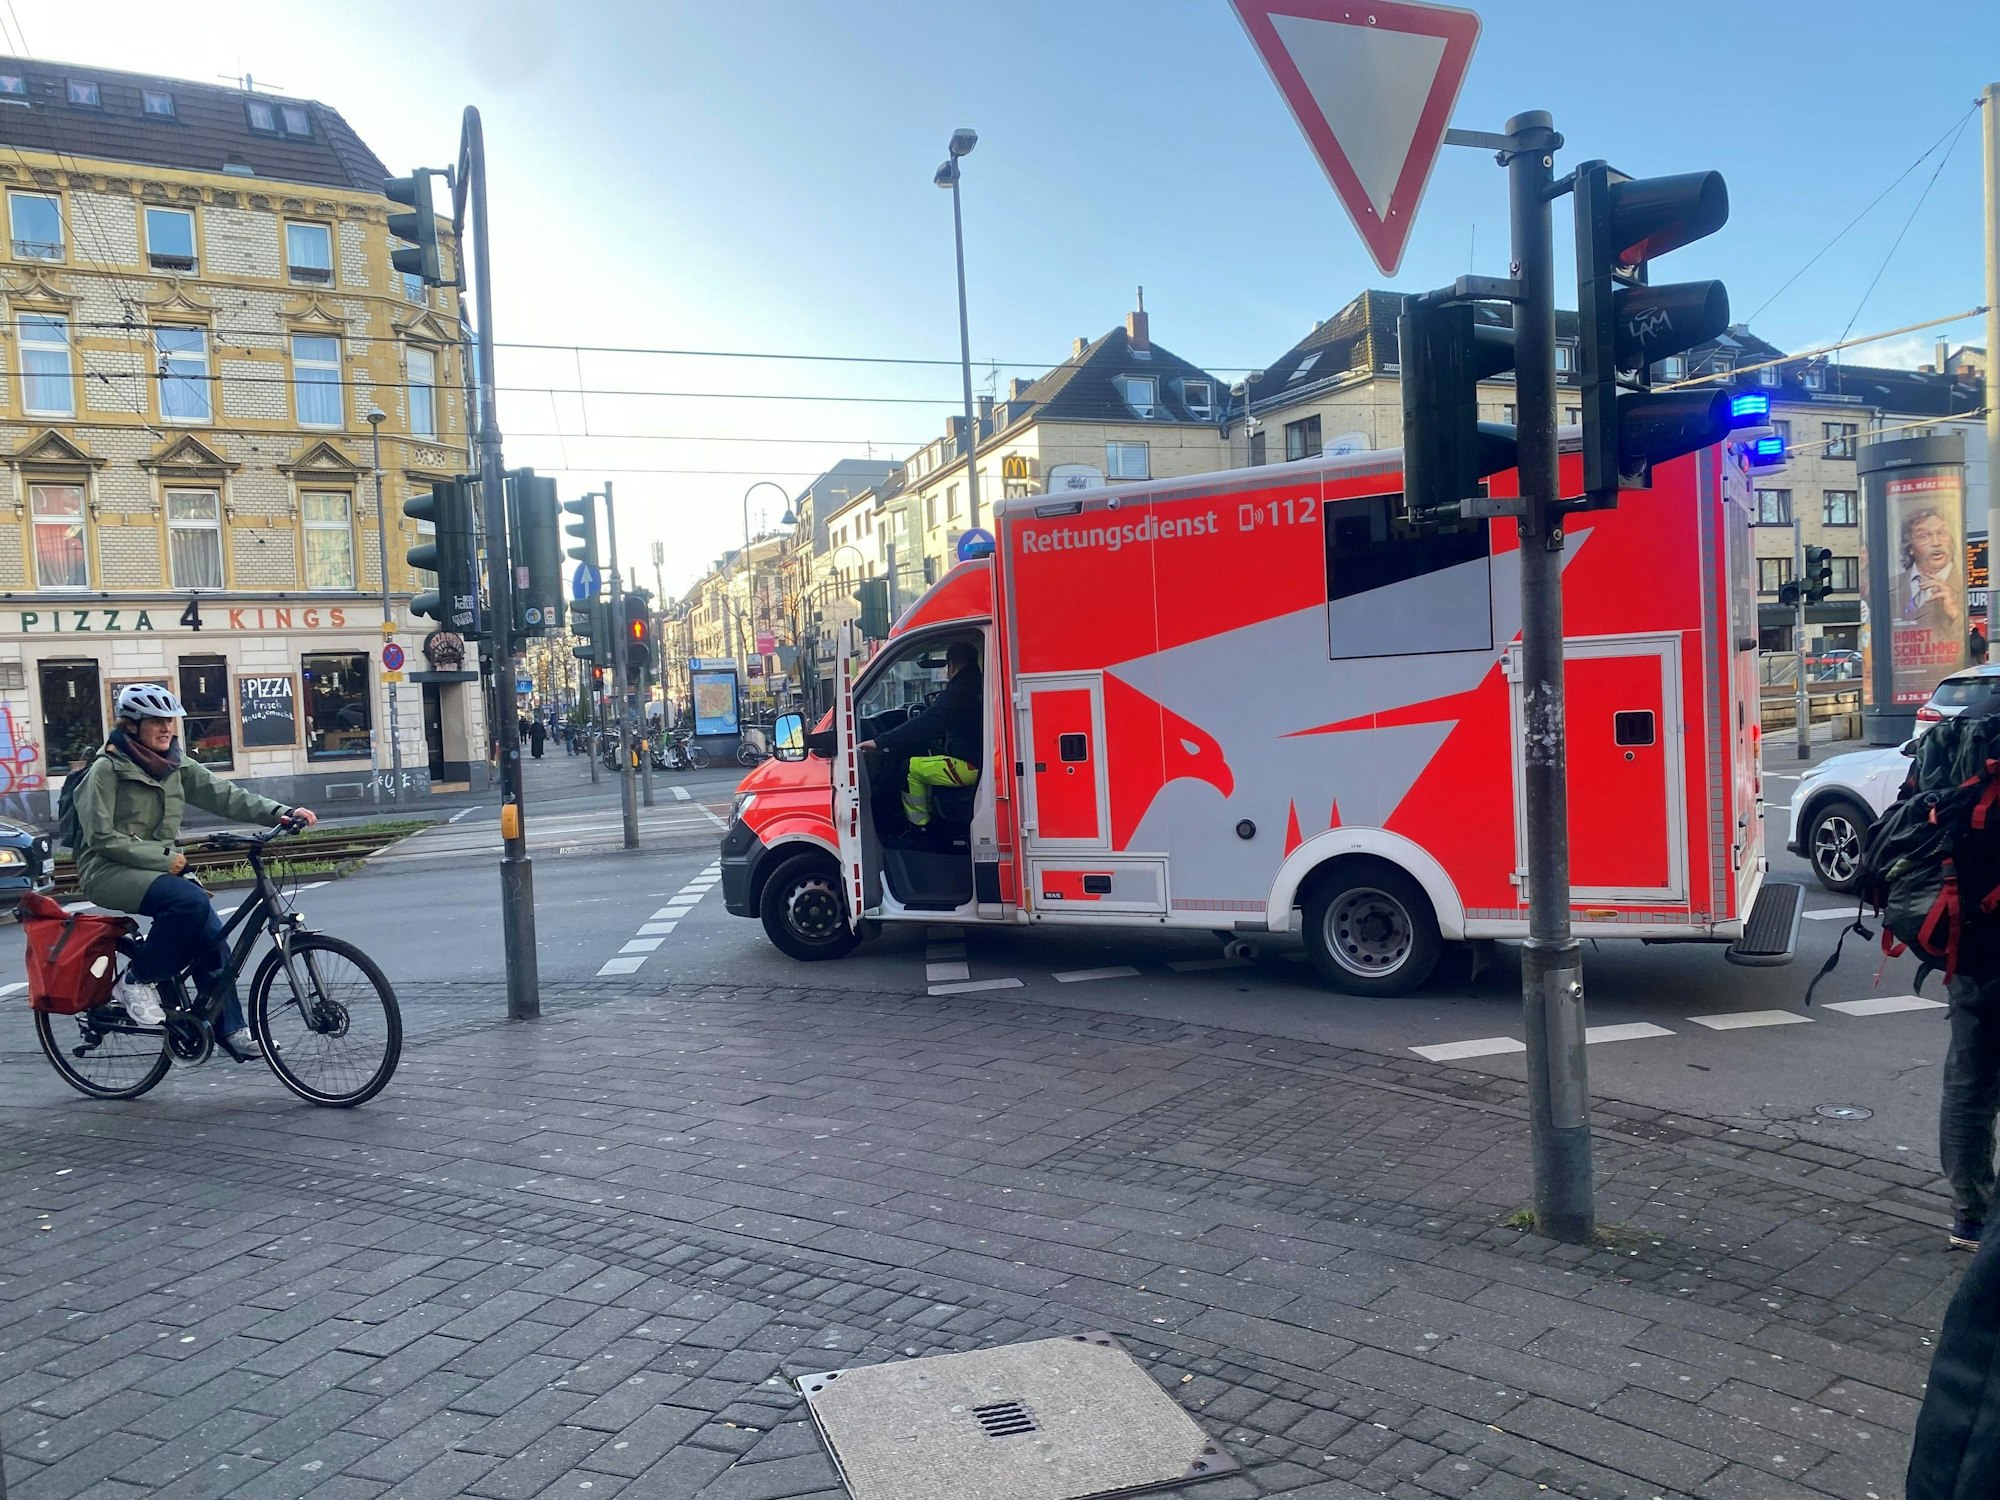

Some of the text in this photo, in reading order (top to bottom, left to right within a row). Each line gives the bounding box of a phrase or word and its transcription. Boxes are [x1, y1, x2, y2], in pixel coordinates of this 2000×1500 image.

[1022, 497, 1317, 554] Rettungsdienst 112
[20, 601, 346, 633] PIZZA 4 KINGS
[1894, 629, 1932, 644] HORST
[247, 678, 293, 698] PIZZA
[253, 699, 282, 710] Frisch
